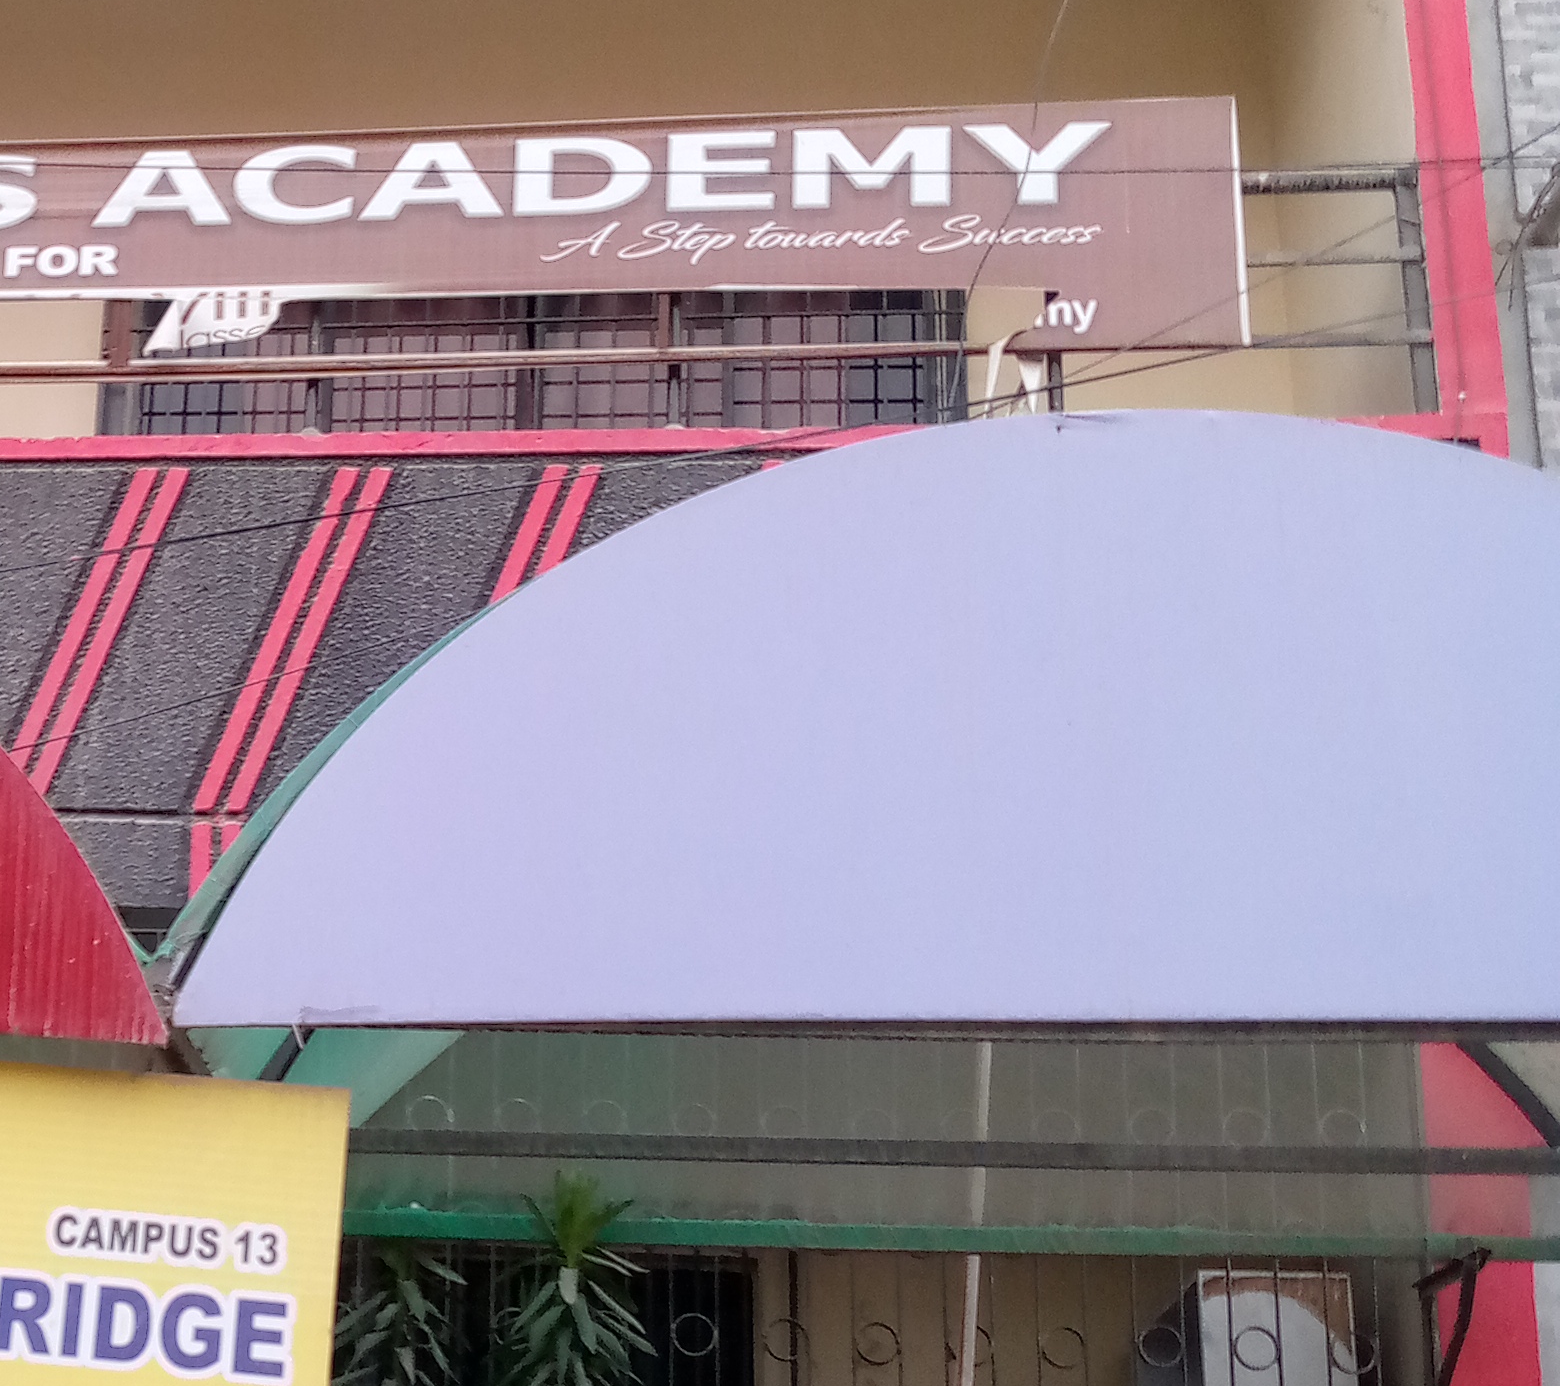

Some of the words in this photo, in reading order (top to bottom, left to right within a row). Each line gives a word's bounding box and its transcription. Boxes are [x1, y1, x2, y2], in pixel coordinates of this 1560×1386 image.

[93, 120, 1113, 228] ACADEMY
[3, 244, 119, 279] FOR
[540, 221, 622, 263] A
[617, 218, 736, 266] Step
[743, 217, 912, 252] towards
[918, 213, 1103, 254] Success
[55, 1213, 219, 1260] CAMPUS
[235, 1229, 279, 1267] 13
